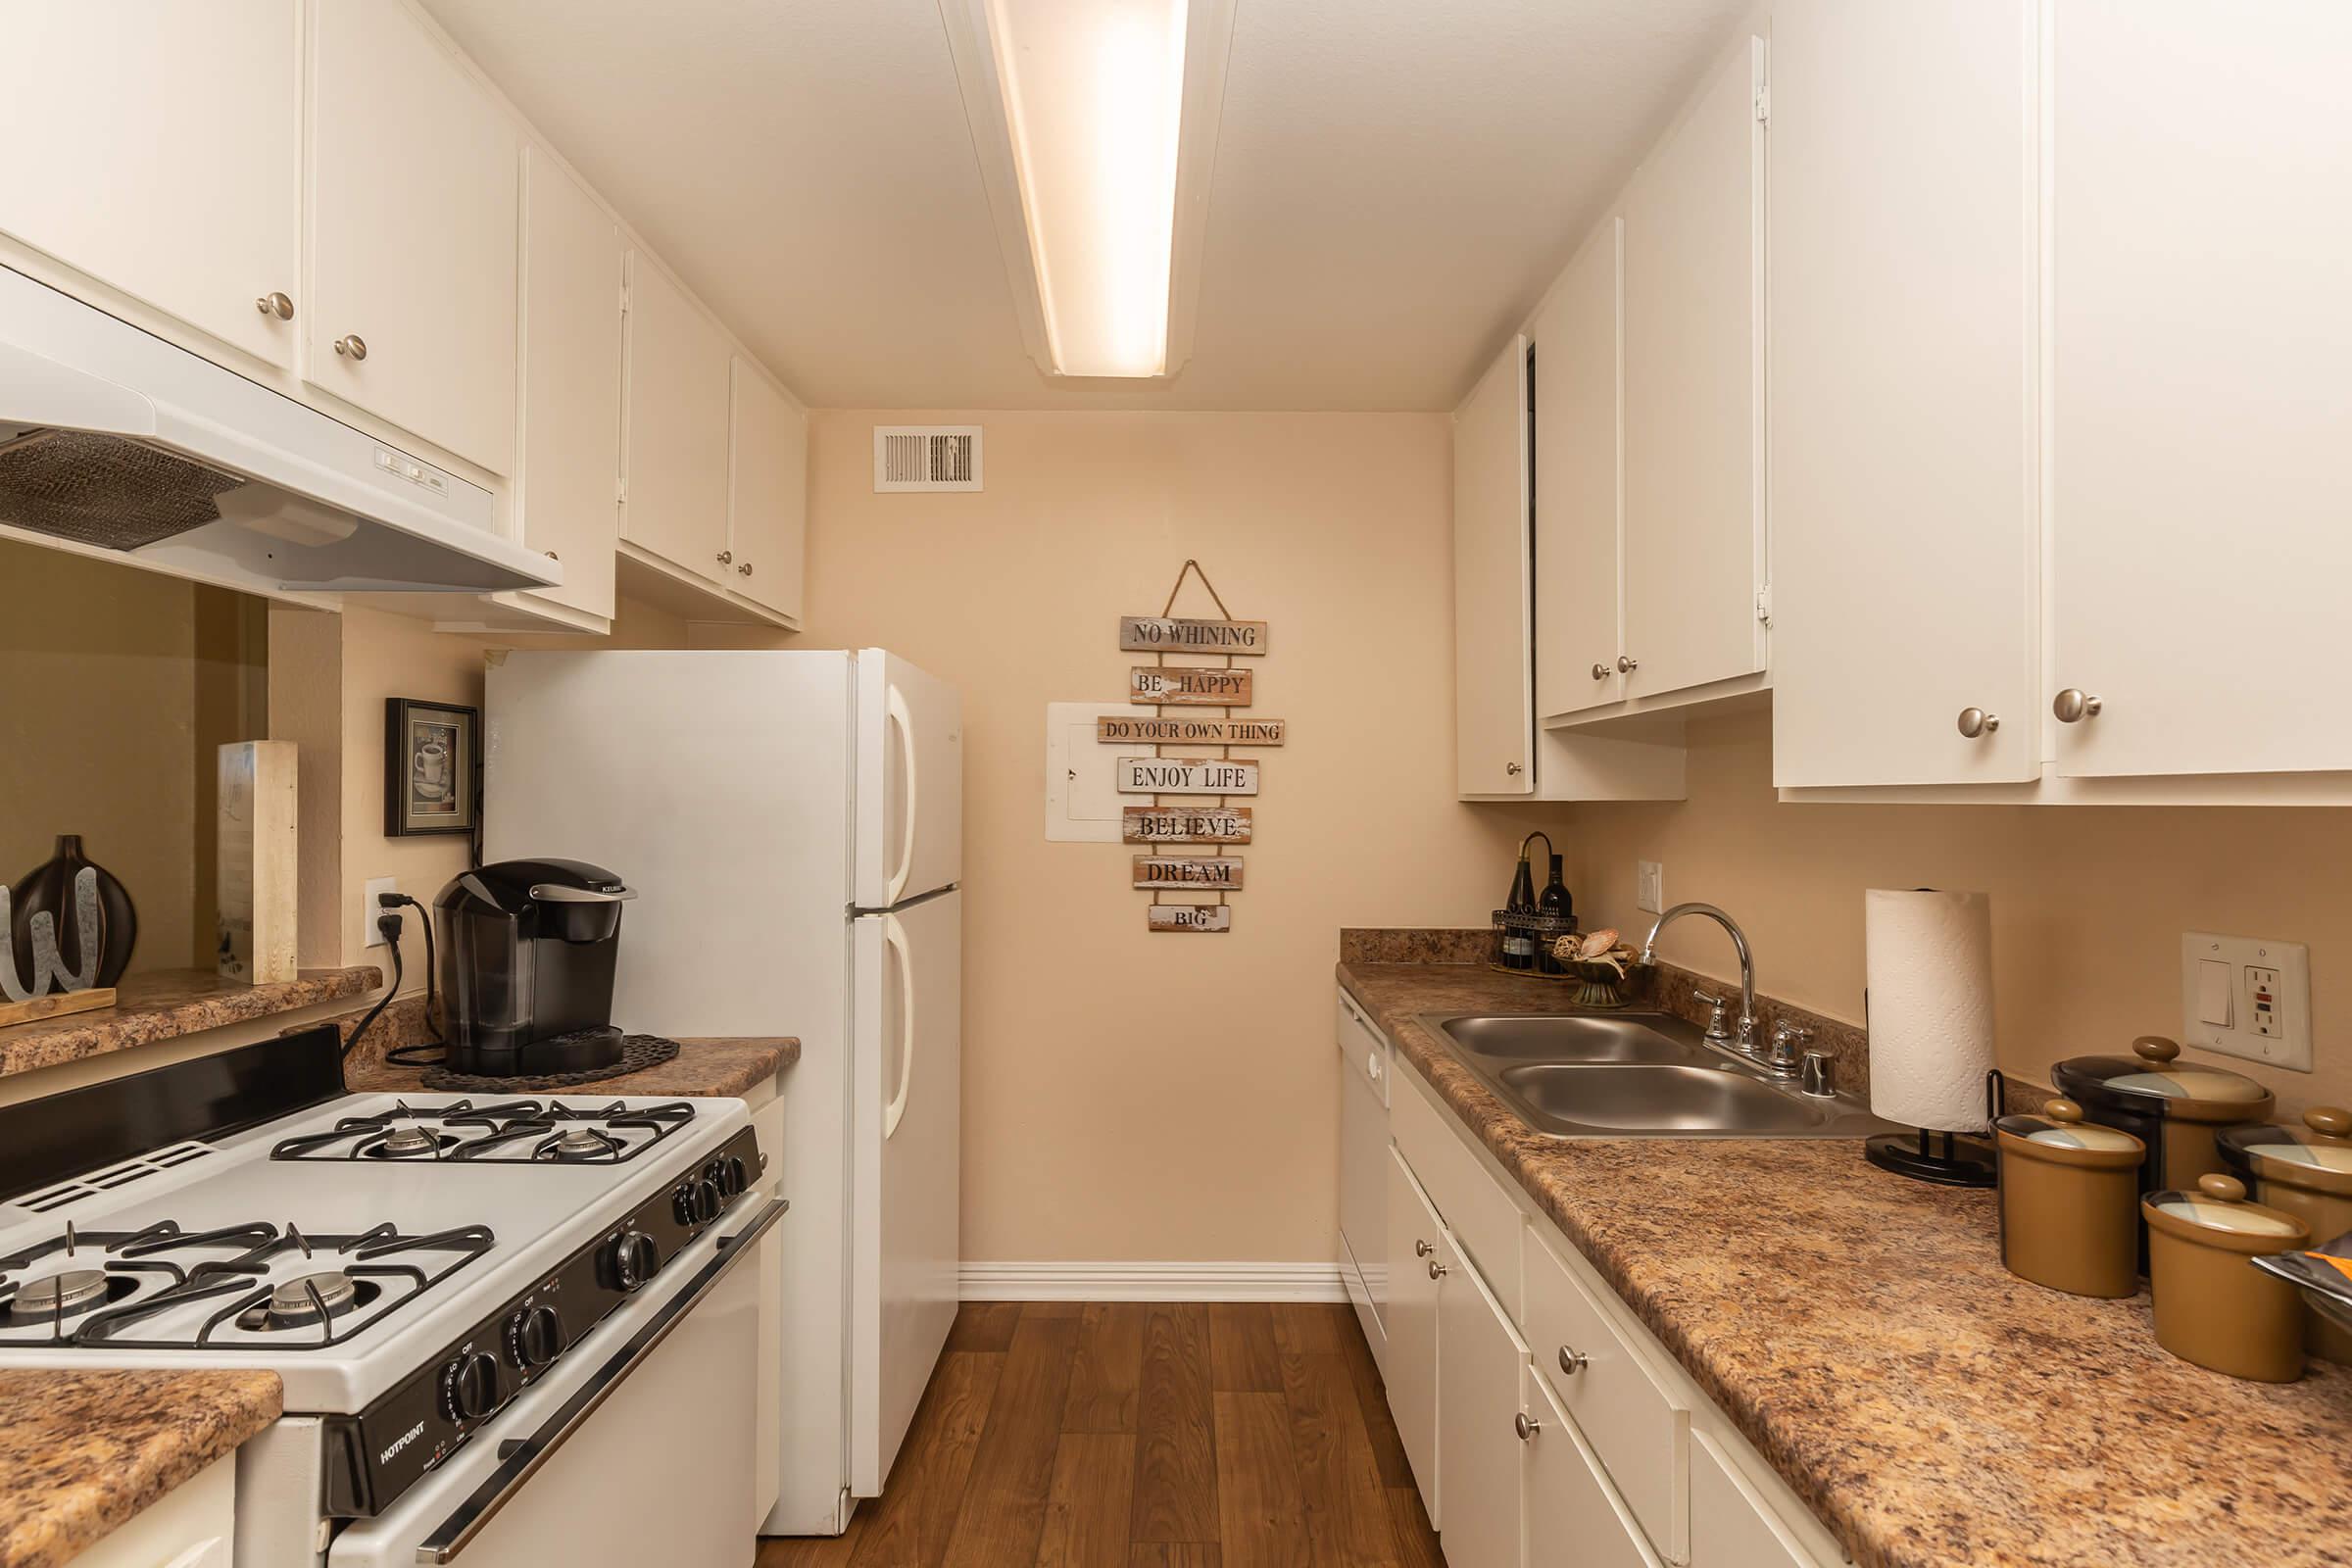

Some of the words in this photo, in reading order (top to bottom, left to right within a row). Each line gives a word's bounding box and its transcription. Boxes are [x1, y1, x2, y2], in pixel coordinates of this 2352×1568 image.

[1133, 624, 1161, 643] NO
[1168, 625, 1255, 647] WHINING
[1138, 674, 1162, 692] BE
[1180, 676, 1244, 694] HAPPY
[1106, 722, 1129, 737] DO
[1134, 722, 1179, 738] YOUR
[1185, 723, 1223, 739] OWN
[1228, 724, 1280, 740] THING
[1132, 766, 1194, 787] ENJOY
[1204, 767, 1247, 788] LIFE
[1140, 817, 1237, 836] BELIEVE
[1148, 863, 1230, 882] DREAM
[1175, 911, 1207, 926] BIG
[380, 1420, 424, 1465] HOTPOINT
